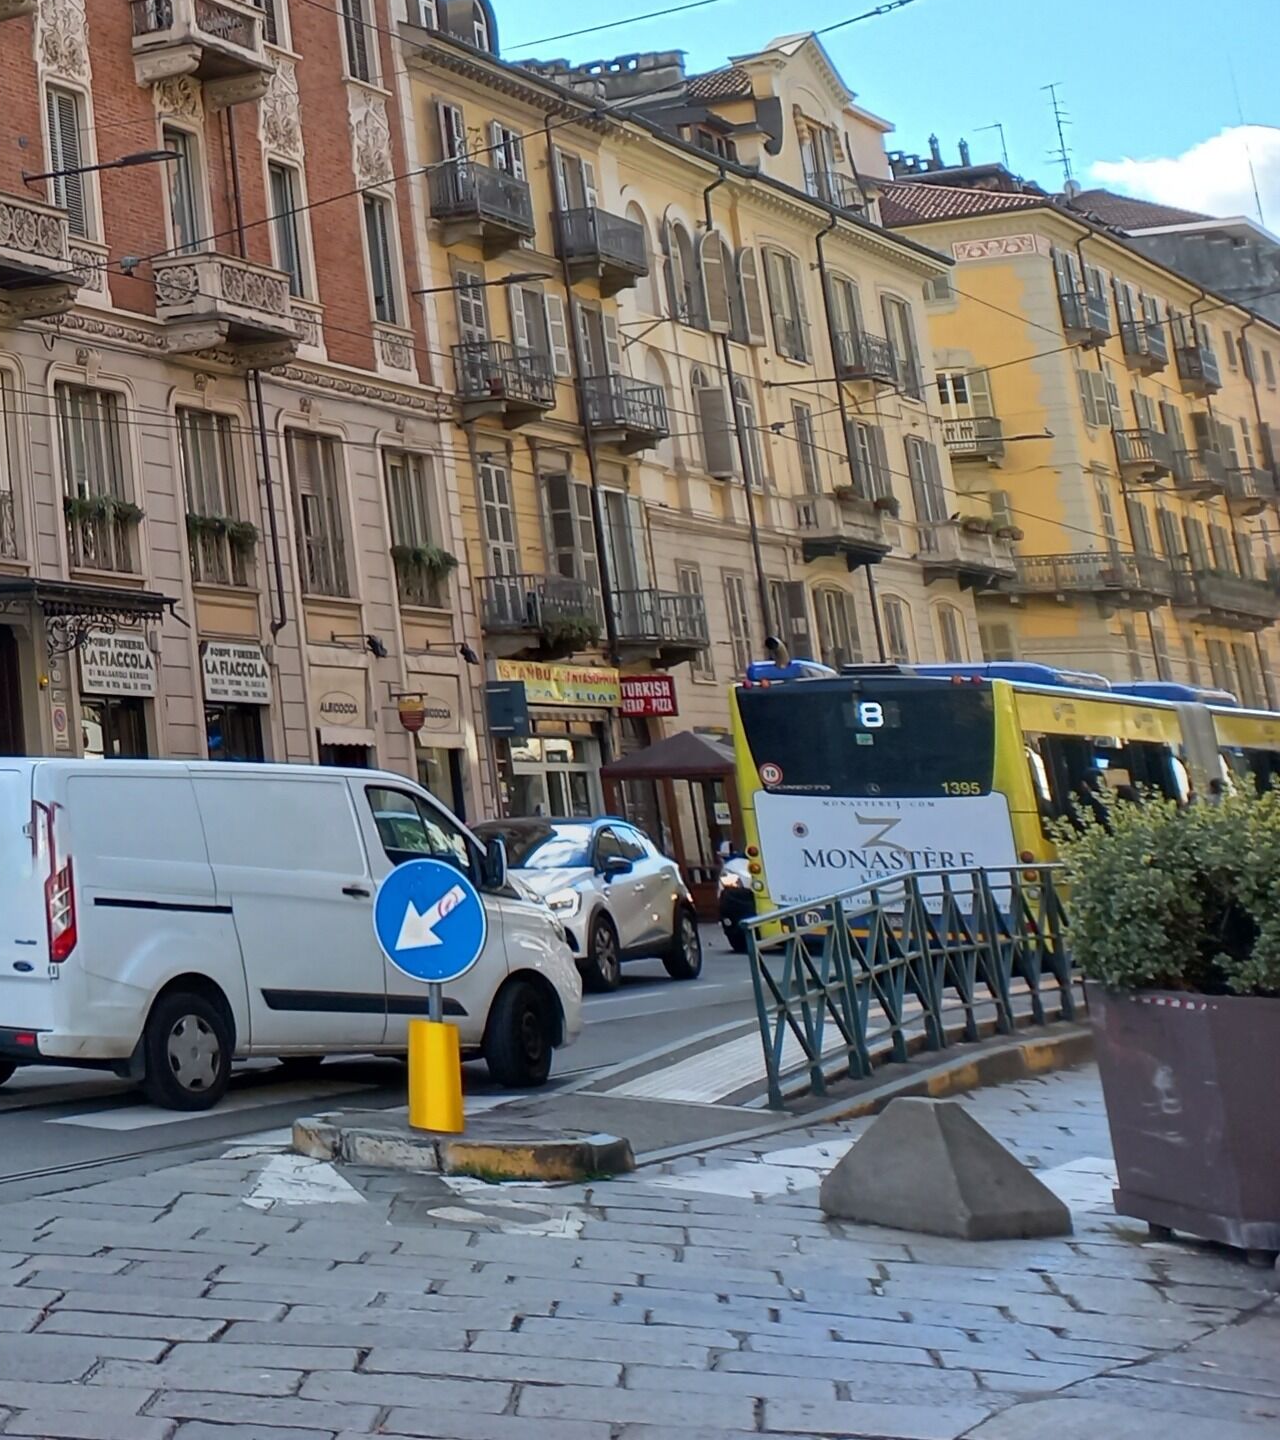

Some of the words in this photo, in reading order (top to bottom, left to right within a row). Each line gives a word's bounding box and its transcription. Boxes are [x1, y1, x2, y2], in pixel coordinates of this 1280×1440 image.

[82, 650, 98, 666] LA
[99, 651, 153, 670] FIACCOLA
[205, 659, 219, 675] LA
[220, 661, 268, 679] FIACCOLA
[621, 681, 671, 697] TURKISH
[652, 698, 673, 713] PIZZA
[860, 701, 884, 728] 8
[942, 782, 981, 795] 1395
[801, 846, 975, 871] MONASTÈRE
